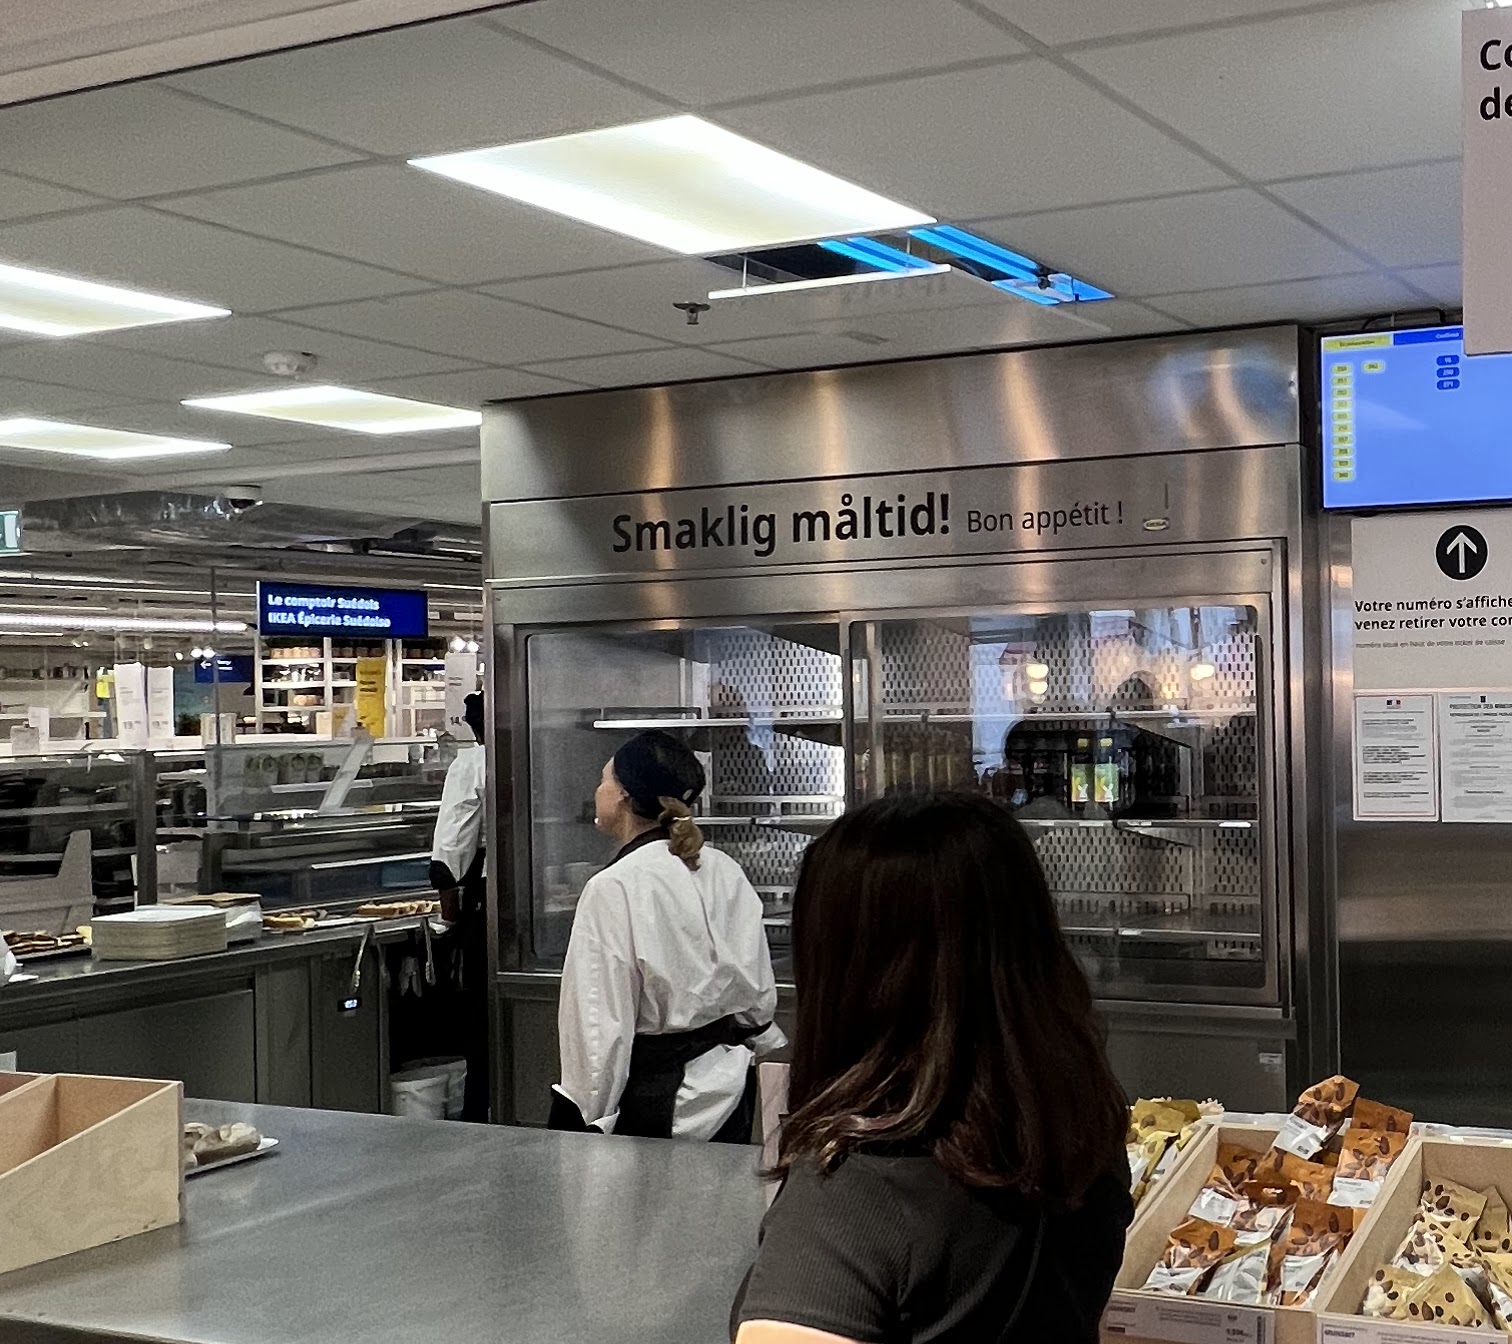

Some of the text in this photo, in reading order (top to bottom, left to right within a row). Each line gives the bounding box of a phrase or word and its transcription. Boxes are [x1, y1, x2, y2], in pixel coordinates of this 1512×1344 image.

[612, 492, 951, 556] Smaklig måltid!
[967, 510, 1013, 533] Bon
[1021, 501, 1110, 536] appétit
[267, 594, 381, 611] Le comptoir Suédois
[1354, 599, 1393, 613] Votre
[1396, 596, 1452, 612] numéro
[268, 611, 392, 628] IKEA Épicerie Suédoise
[1354, 618, 1396, 631] venez
[1399, 615, 1446, 630] retirer
[1449, 615, 1487, 629] votre
